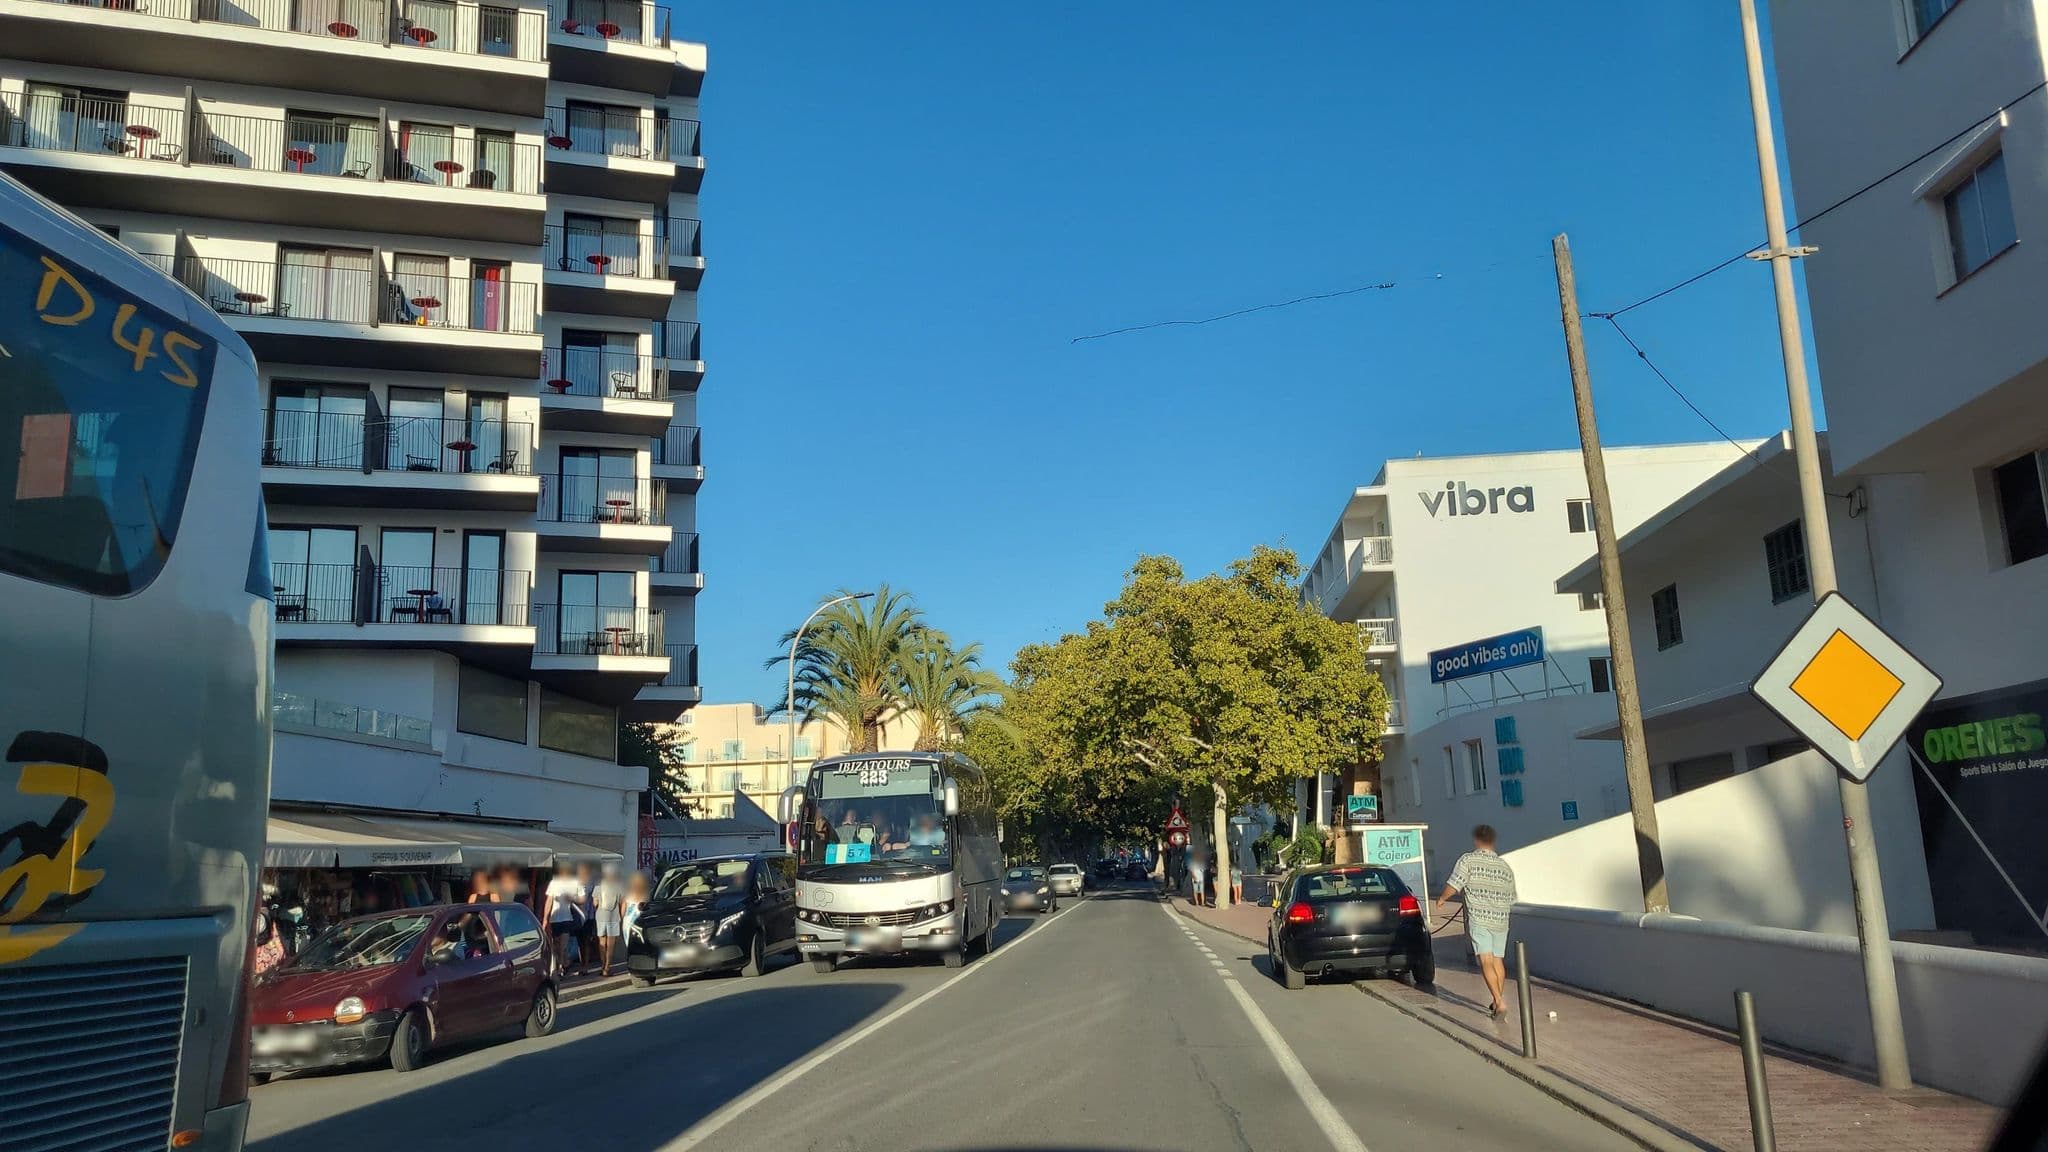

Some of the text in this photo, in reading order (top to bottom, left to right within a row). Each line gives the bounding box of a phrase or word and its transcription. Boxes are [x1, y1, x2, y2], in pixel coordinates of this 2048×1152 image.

[1418, 480, 1535, 518] vibra
[1436, 636, 1541, 677] good vibes only
[1923, 712, 2043, 764] ORENES
[833, 759, 911, 774] IBIZATOURS
[1350, 796, 1376, 807] ATM
[1378, 836, 1410, 848] ATM
[655, 848, 698, 863] WASH
[1378, 850, 1411, 861] Cajero
